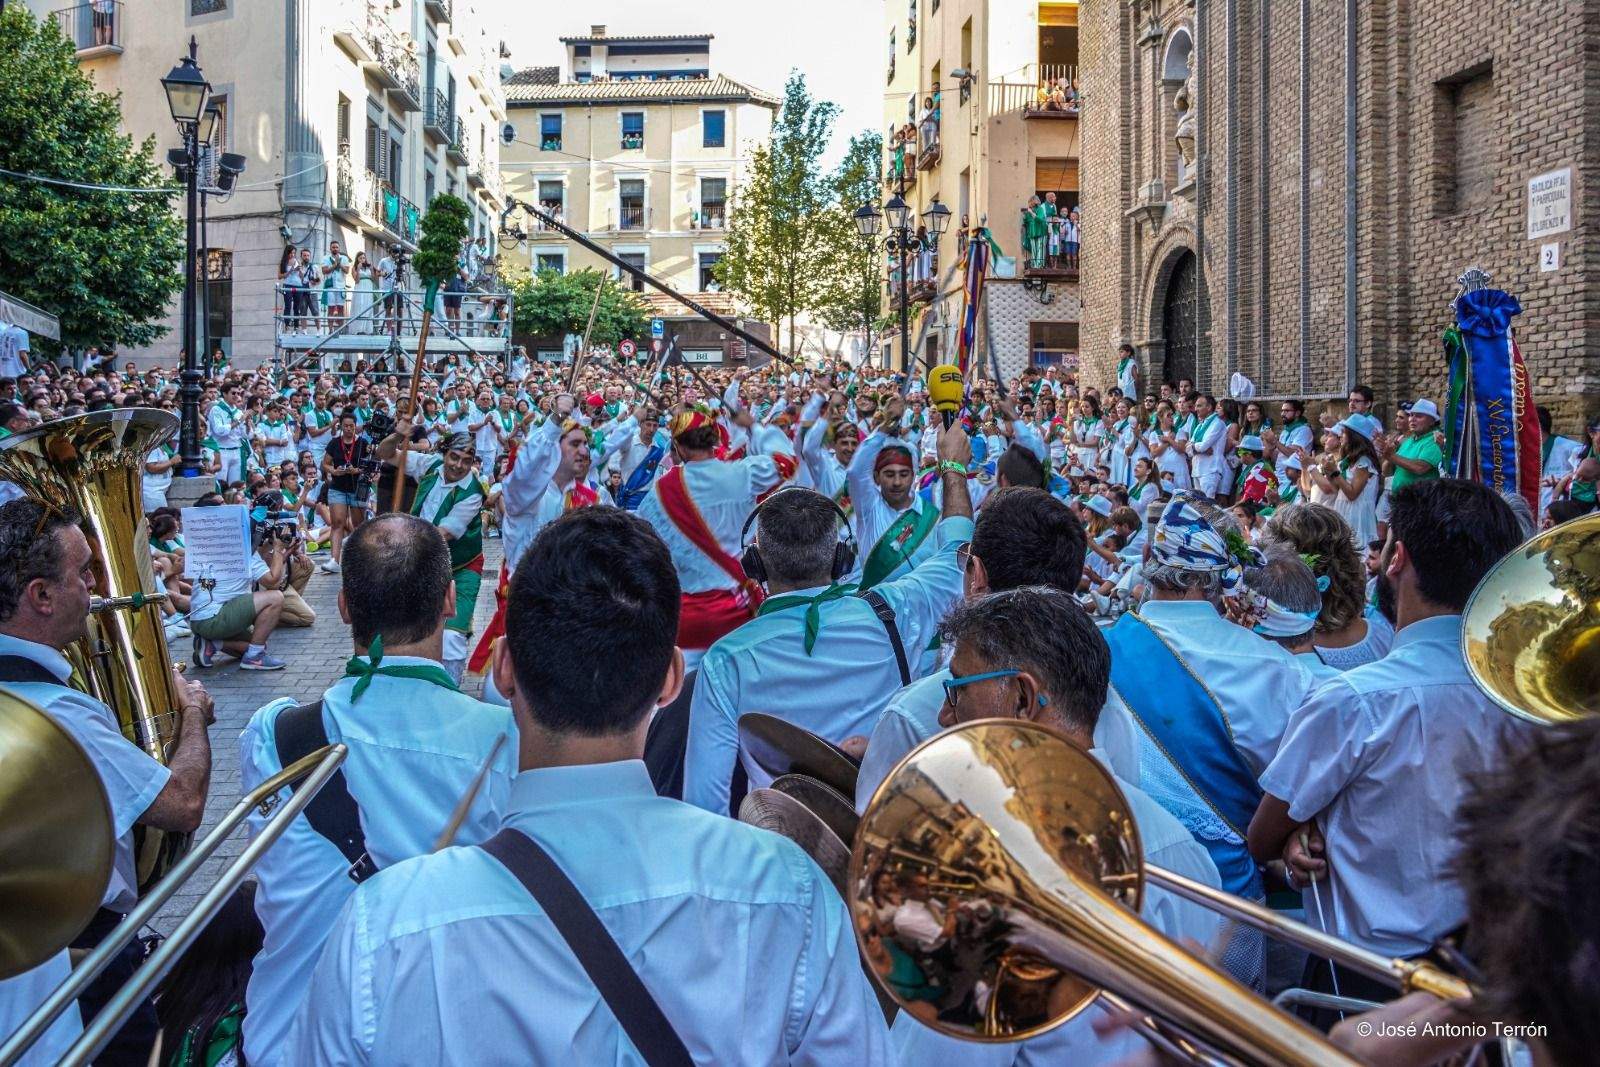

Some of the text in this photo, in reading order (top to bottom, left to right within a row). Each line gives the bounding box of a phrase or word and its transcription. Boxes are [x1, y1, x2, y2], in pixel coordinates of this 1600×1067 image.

[1544, 205, 1552, 217] DE
[1546, 250, 1553, 265] 2
[1487, 397, 1506, 423] XV
